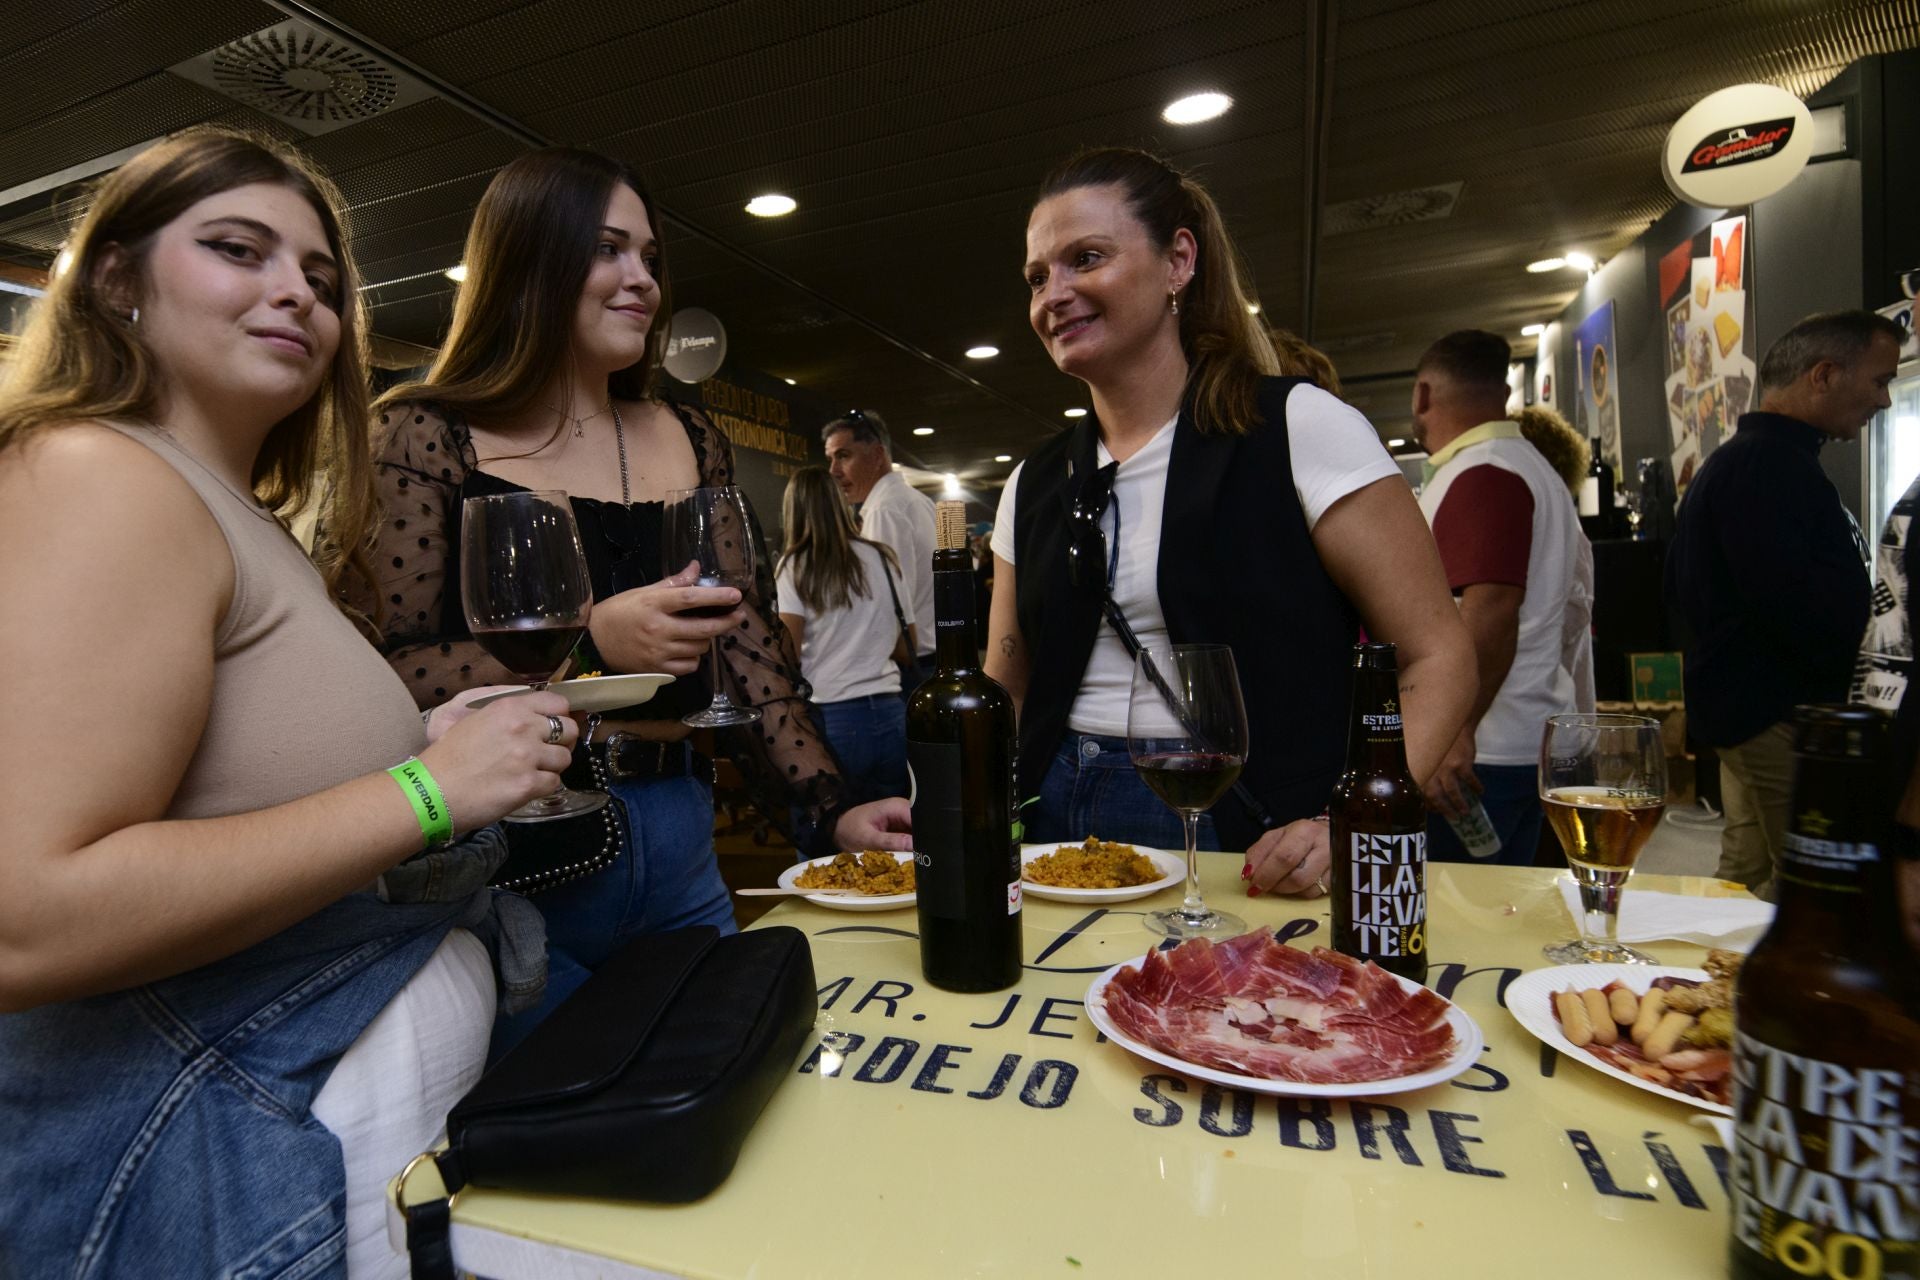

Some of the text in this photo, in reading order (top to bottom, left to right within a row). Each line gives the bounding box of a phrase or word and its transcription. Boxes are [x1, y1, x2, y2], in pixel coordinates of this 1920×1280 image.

[411, 777, 438, 821] VERDAD
[1407, 921, 1428, 955] 6
[1133, 1073, 1507, 1179] SOBRE
[1776, 1218, 1884, 1280] 60
